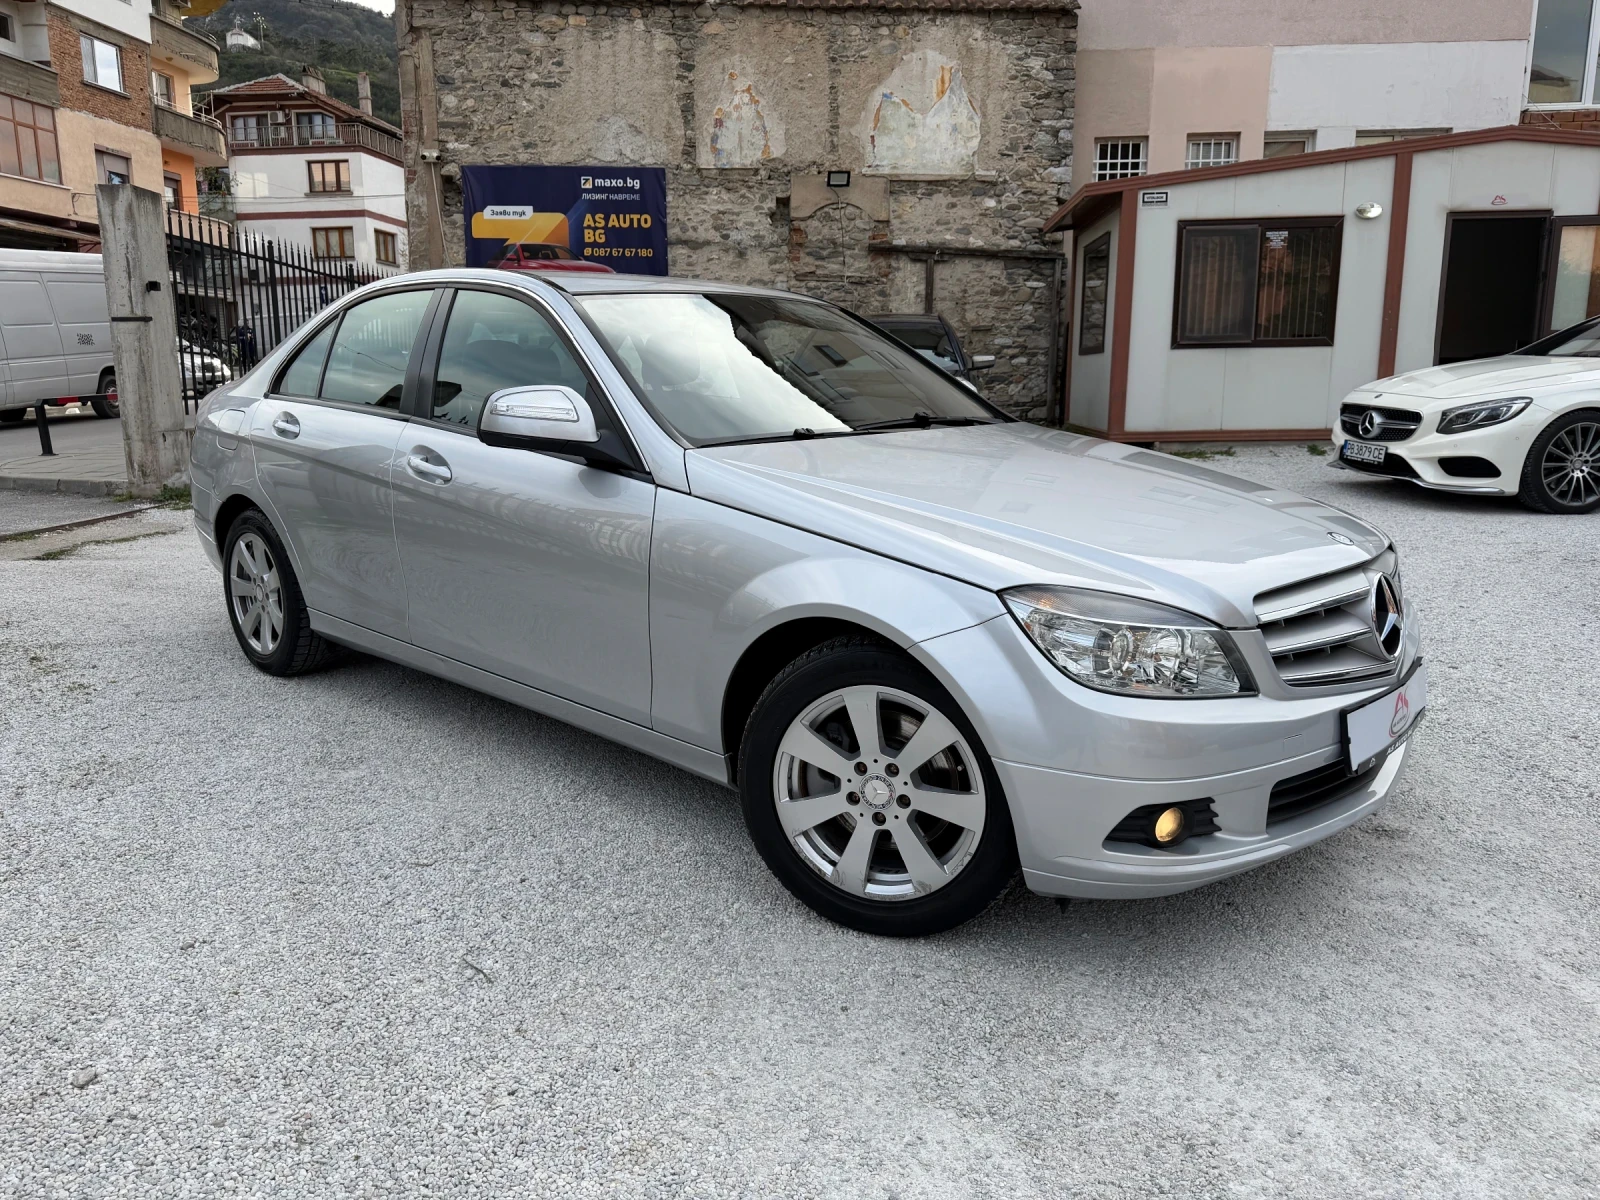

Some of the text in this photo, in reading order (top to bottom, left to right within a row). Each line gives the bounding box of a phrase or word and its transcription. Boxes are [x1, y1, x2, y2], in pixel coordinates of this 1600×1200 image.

[594, 177, 640, 189] maxo.bg
[512, 209, 527, 217] тук
[583, 213, 652, 228] AS AUTO
[584, 229, 606, 243] BG
[593, 248, 653, 257] 087 67 67 180
